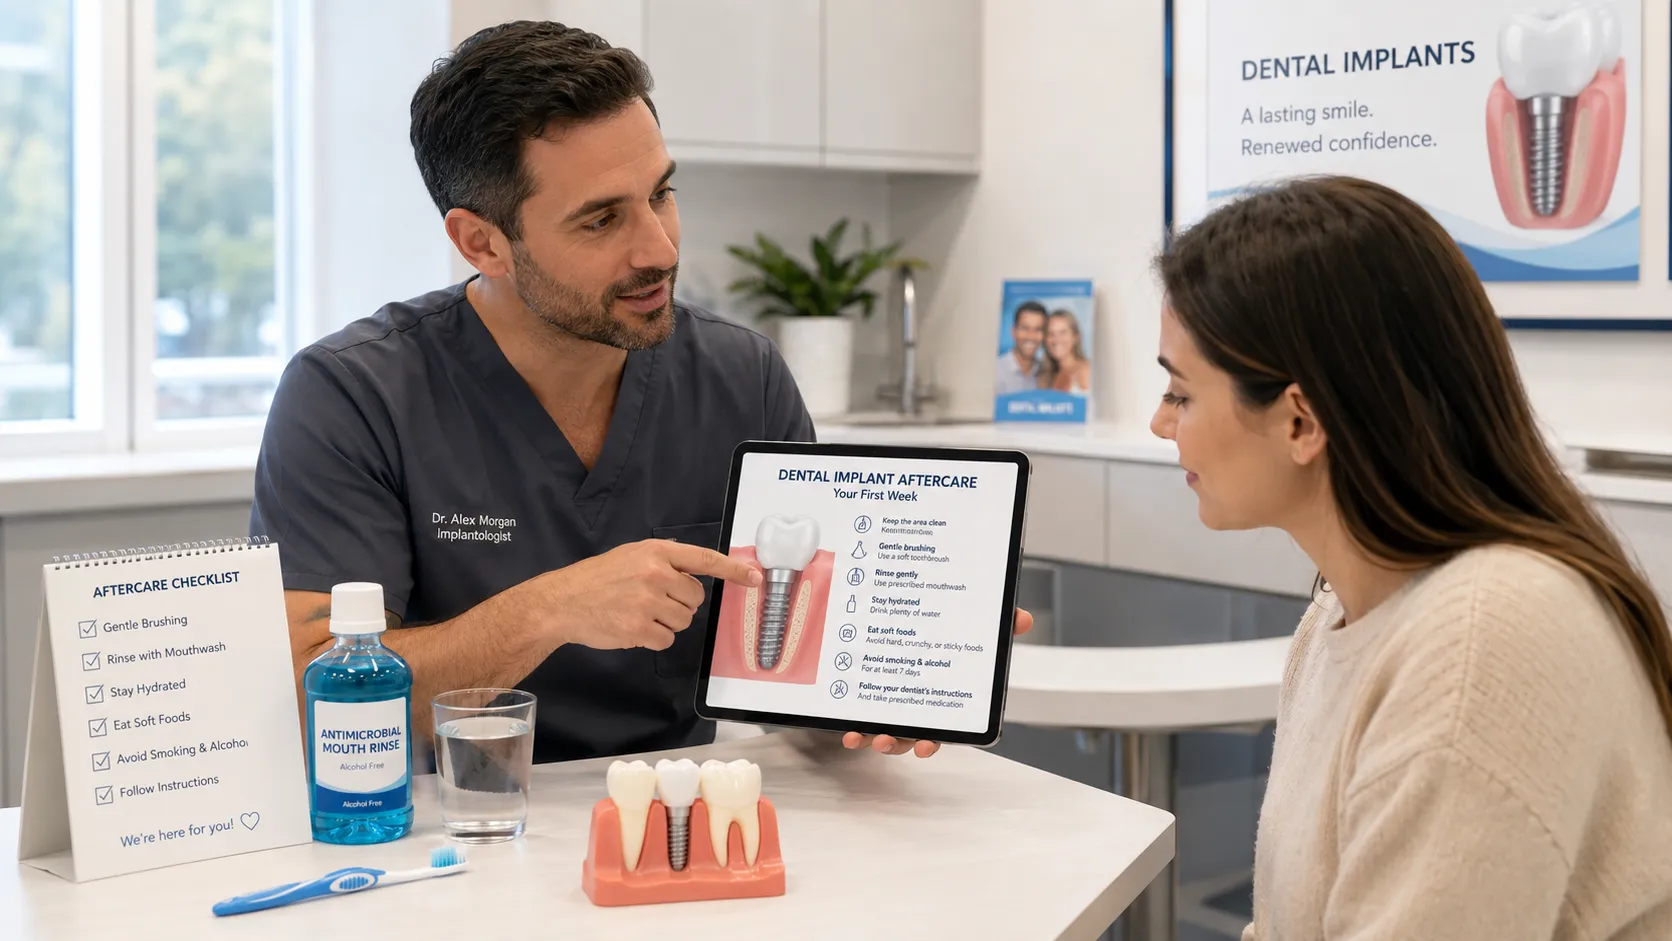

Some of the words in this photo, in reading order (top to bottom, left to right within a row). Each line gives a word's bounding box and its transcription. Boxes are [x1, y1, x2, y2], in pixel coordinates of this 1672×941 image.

[1242, 53, 1335, 81] DENTAL
[1344, 40, 1476, 73] IMPLANTS
[1241, 108, 1253, 125] A
[1259, 105, 1316, 125] lasting
[1322, 100, 1373, 120] smile.
[1241, 134, 1322, 156] Renewed
[1329, 131, 1437, 151] confidence.
[778, 469, 830, 483] DENTAL
[834, 471, 895, 485] IMPLANT
[898, 474, 978, 488] AFTERCARE
[834, 488, 858, 499] Your
[861, 490, 884, 500] First
[888, 491, 918, 502] Week
[432, 513, 447, 523] Dr.
[451, 514, 475, 525] Alex
[480, 515, 516, 529] Morgan
[882, 518, 900, 526] Keep
[437, 528, 511, 543] Implantologist
[879, 543, 903, 551] Gentle
[904, 544, 936, 554] brushing
[875, 569, 895, 577] Rinse
[896, 571, 918, 579] gently
[93, 580, 168, 598] AFTERCARE
[172, 571, 240, 589] CHECKLIST
[888, 580, 925, 590] prescribed
[926, 583, 966, 591] mouthwash
[872, 596, 887, 605] Stay
[888, 597, 920, 606] hydrated
[889, 608, 911, 617] plenty
[103, 619, 139, 633] Gentle
[142, 616, 188, 629] Brushing
[880, 627, 894, 635] soft
[896, 628, 916, 636] foods
[866, 637, 885, 645] Avoid
[886, 638, 904, 646] hard,
[905, 640, 933, 649] crunchy,
[943, 642, 963, 651] sticky
[964, 644, 983, 652] foods
[107, 653, 136, 664] Rinse
[139, 649, 162, 660] with
[165, 642, 226, 657] Mouthwash
[863, 655, 884, 663] Avoid
[885, 656, 915, 666] smoking
[925, 659, 951, 667] alcohol
[905, 668, 921, 676] days
[110, 685, 134, 698] Stay
[137, 679, 186, 694] Hydrated
[859, 682, 881, 690] Follow
[883, 685, 899, 693] your
[931, 688, 972, 698] instructions
[873, 694, 888, 702] take
[926, 698, 963, 708] medication
[114, 720, 131, 731] Eat
[134, 715, 156, 728] Soft
[159, 712, 191, 724] Foods
[321, 726, 401, 740] ANTIMICROBIAL
[117, 751, 147, 764] Avoid
[150, 745, 196, 760] Smoking
[199, 743, 207, 753] &
[323, 743, 366, 754] MOUTH
[370, 740, 400, 753] RINSE
[119, 785, 155, 797] Follow
[158, 776, 219, 792] Instructions
[120, 832, 156, 847] We're
[159, 829, 185, 841] here
[189, 825, 206, 836] for
[209, 818, 234, 836] you!
